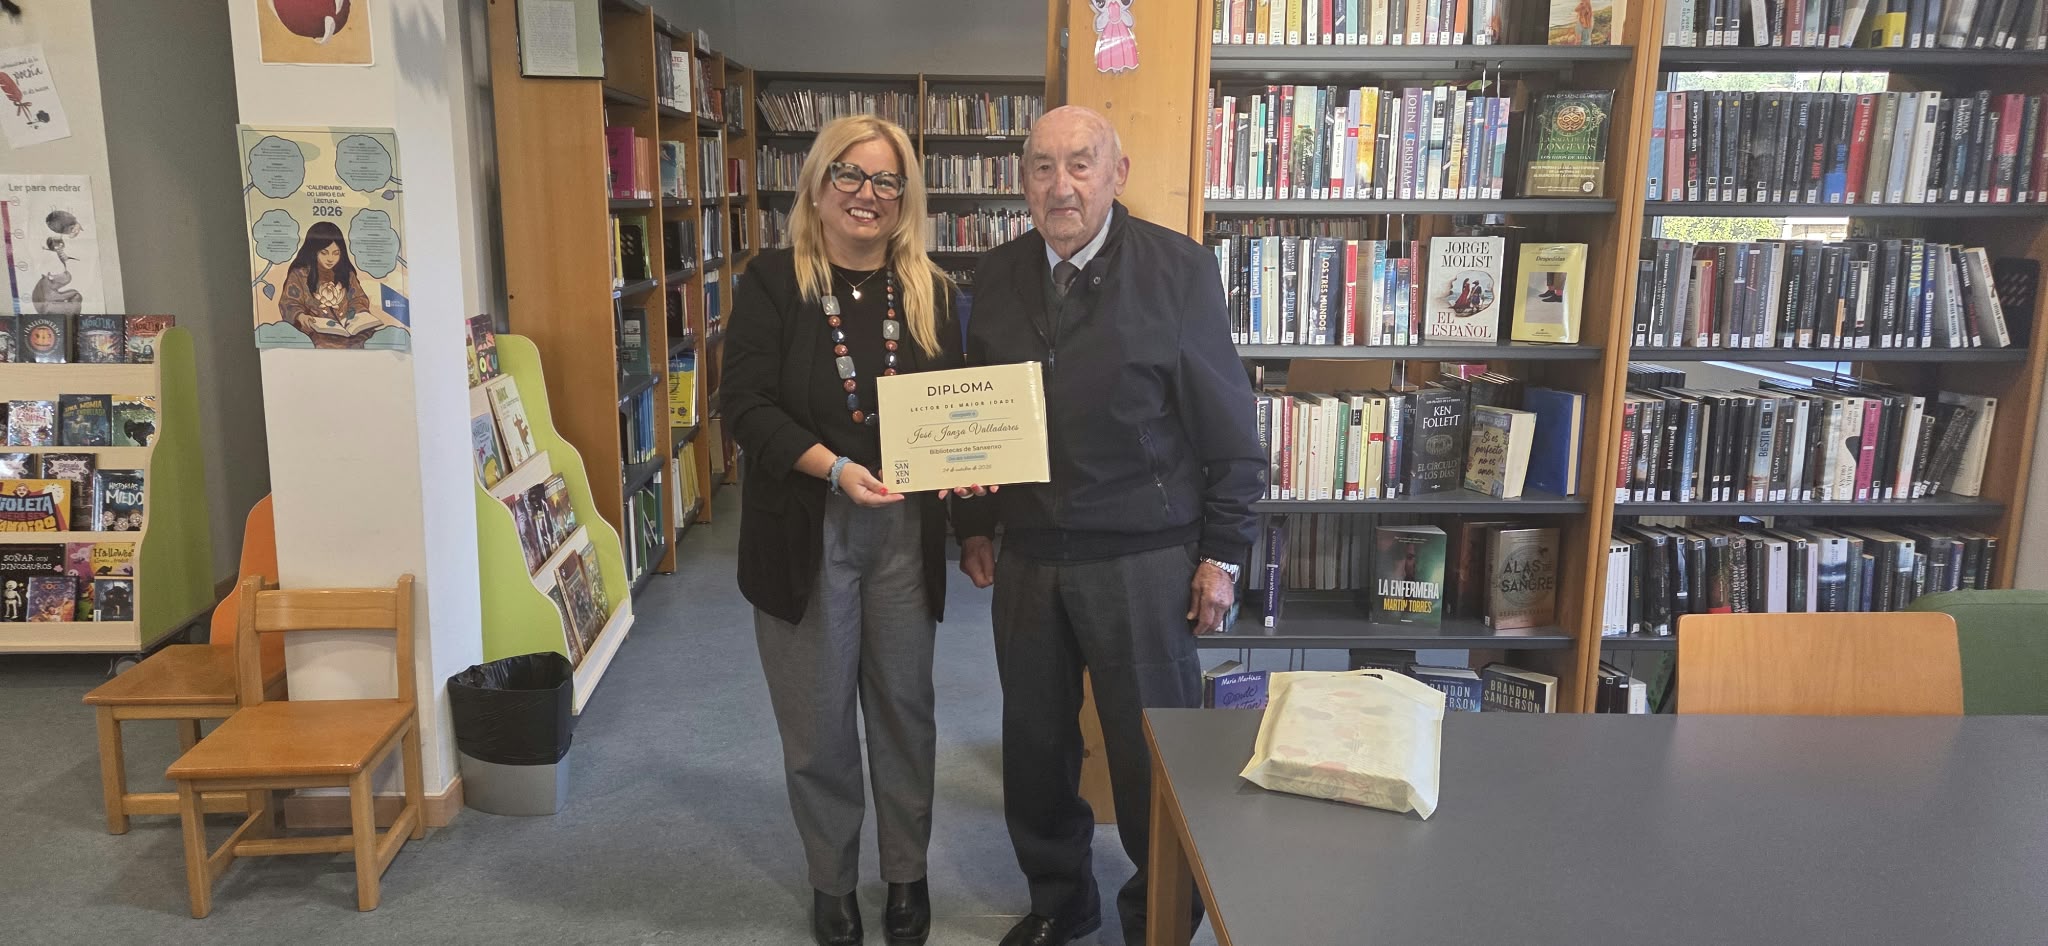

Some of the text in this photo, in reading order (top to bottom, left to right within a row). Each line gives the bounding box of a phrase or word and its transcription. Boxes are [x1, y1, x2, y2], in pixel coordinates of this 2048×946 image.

[1798, 103, 1807, 126] CICATRIZ
[1954, 106, 1970, 141] PAULA HAWKINS
[1403, 94, 1418, 184] JOHN GRISHAM
[1836, 144, 1847, 161] TODO
[1811, 143, 1823, 179] TODO ARDE
[8, 184, 81, 193] Ler para medrar
[312, 205, 343, 217] 2026
[1445, 242, 1490, 254] JORGE
[1441, 255, 1493, 268] MOLIST
[1909, 245, 1924, 289] ENIGMA
[1318, 257, 1329, 331] LOS TRES MUNDOS
[1925, 300, 1934, 314] FREIDA
[1437, 312, 1455, 324] EL
[24, 319, 59, 334] HALLOWEEN
[1431, 322, 1492, 338] ESPAÑOL
[927, 381, 994, 397] DIPLOMA
[910, 405, 940, 413] LECTOR
[1434, 405, 1452, 416] KEN
[1422, 414, 1461, 429] FOLLETT
[907, 427, 933, 444] José
[968, 422, 1020, 435] Valladares
[1481, 431, 1499, 444] Si es
[929, 447, 962, 455] Bibliotecas
[972, 444, 1002, 452] Sanxenxo
[1474, 443, 1504, 456] perfecto
[1418, 460, 1458, 472] EL CÍRCULO
[1477, 467, 1495, 476] amor
[1424, 469, 1455, 480] LOS DÍAS
[106, 490, 144, 506] MIEDO
[3, 552, 34, 562] SOÑAR
[0, 563, 52, 571] DINOSAUROS
[1503, 559, 1542, 574] ALAS
[1378, 578, 1440, 599] LA ENFERMERA
[1501, 576, 1553, 593] SANGRE
[1383, 597, 1433, 614] MARTÍN TORRES
[1221, 674, 1262, 686] María Martínez
[1490, 679, 1535, 700] BRANDON
[1483, 690, 1540, 714] SANDERSON
